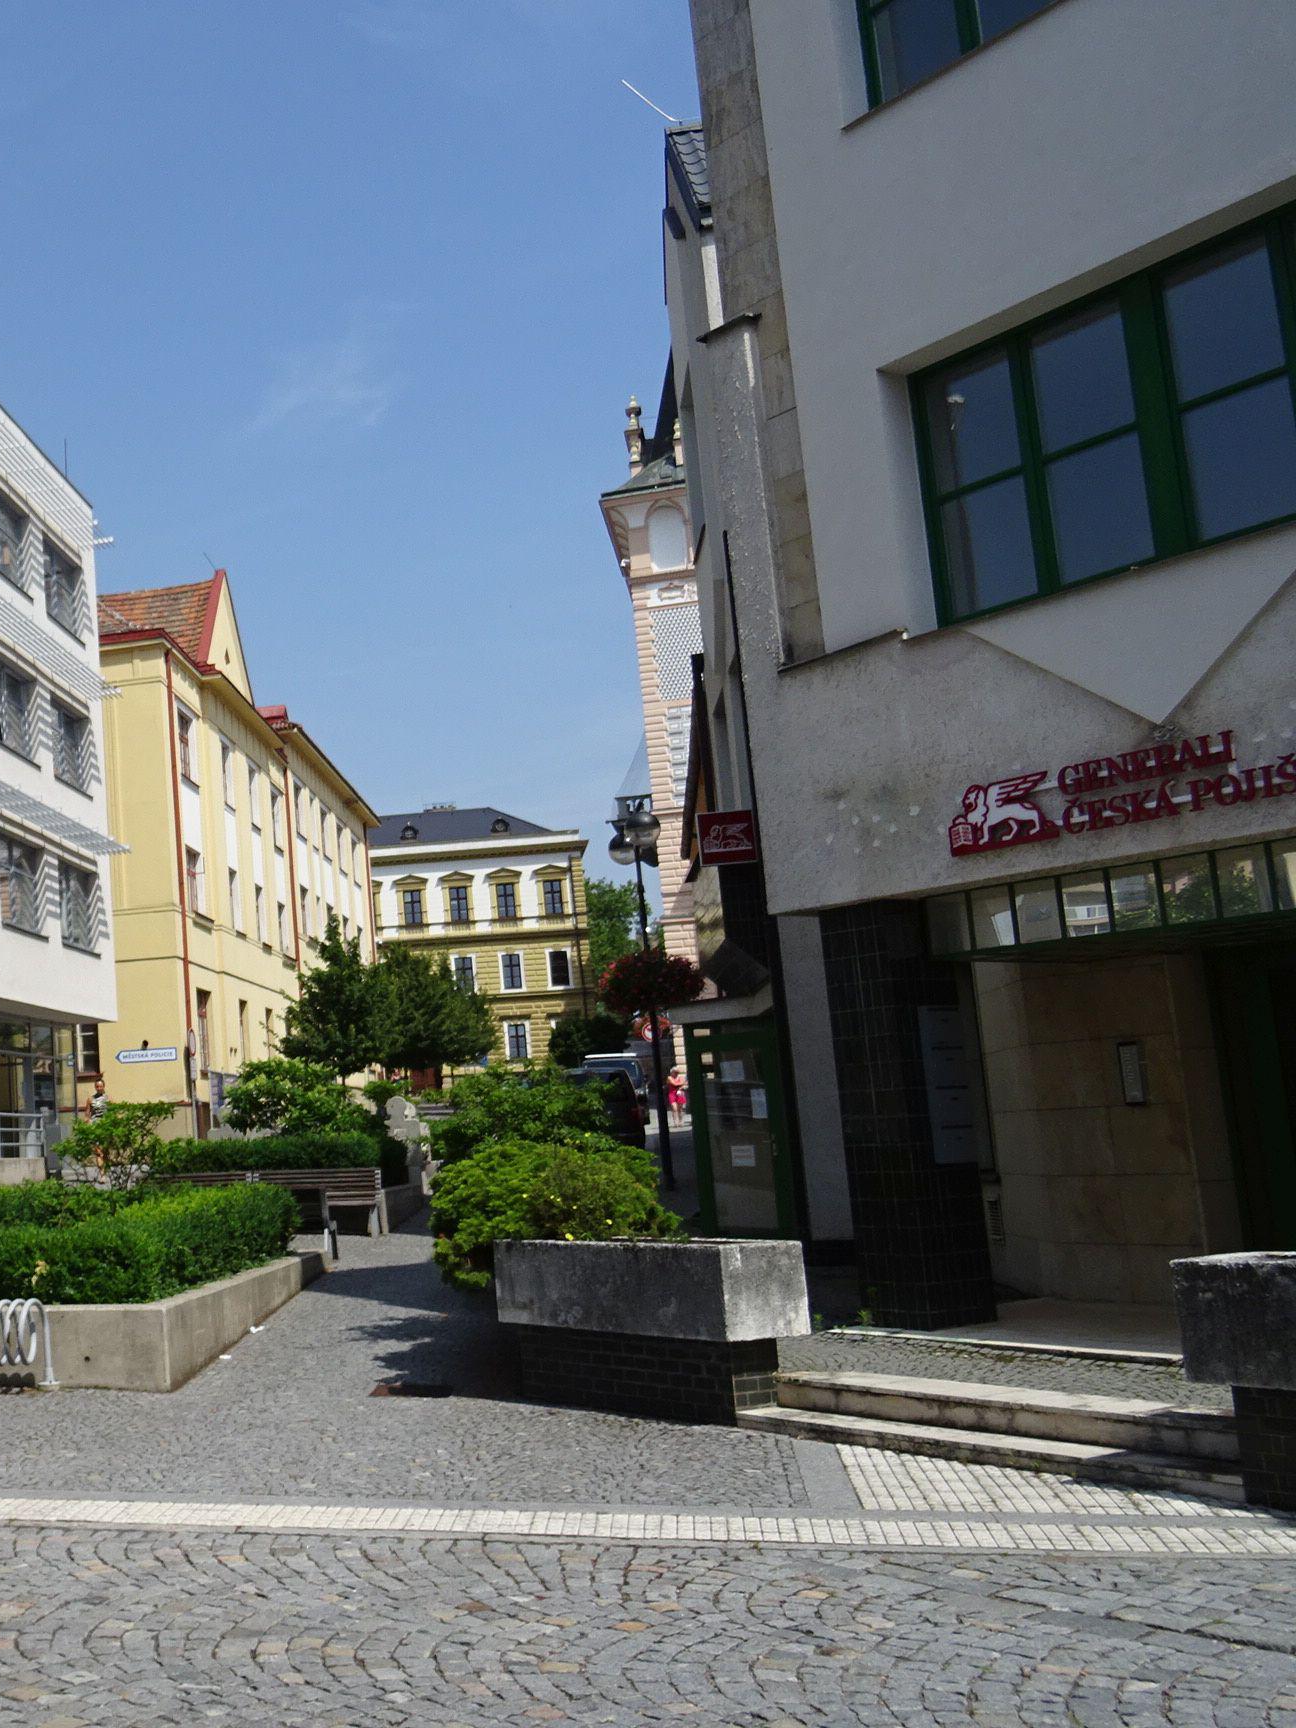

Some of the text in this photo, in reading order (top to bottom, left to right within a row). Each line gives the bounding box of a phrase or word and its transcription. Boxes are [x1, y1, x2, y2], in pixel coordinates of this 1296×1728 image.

[1057, 730, 1236, 795] GENERALI
[1061, 777, 1181, 835] ČESKÁ
[122, 1051, 149, 1060] MĚSTSKÁ
